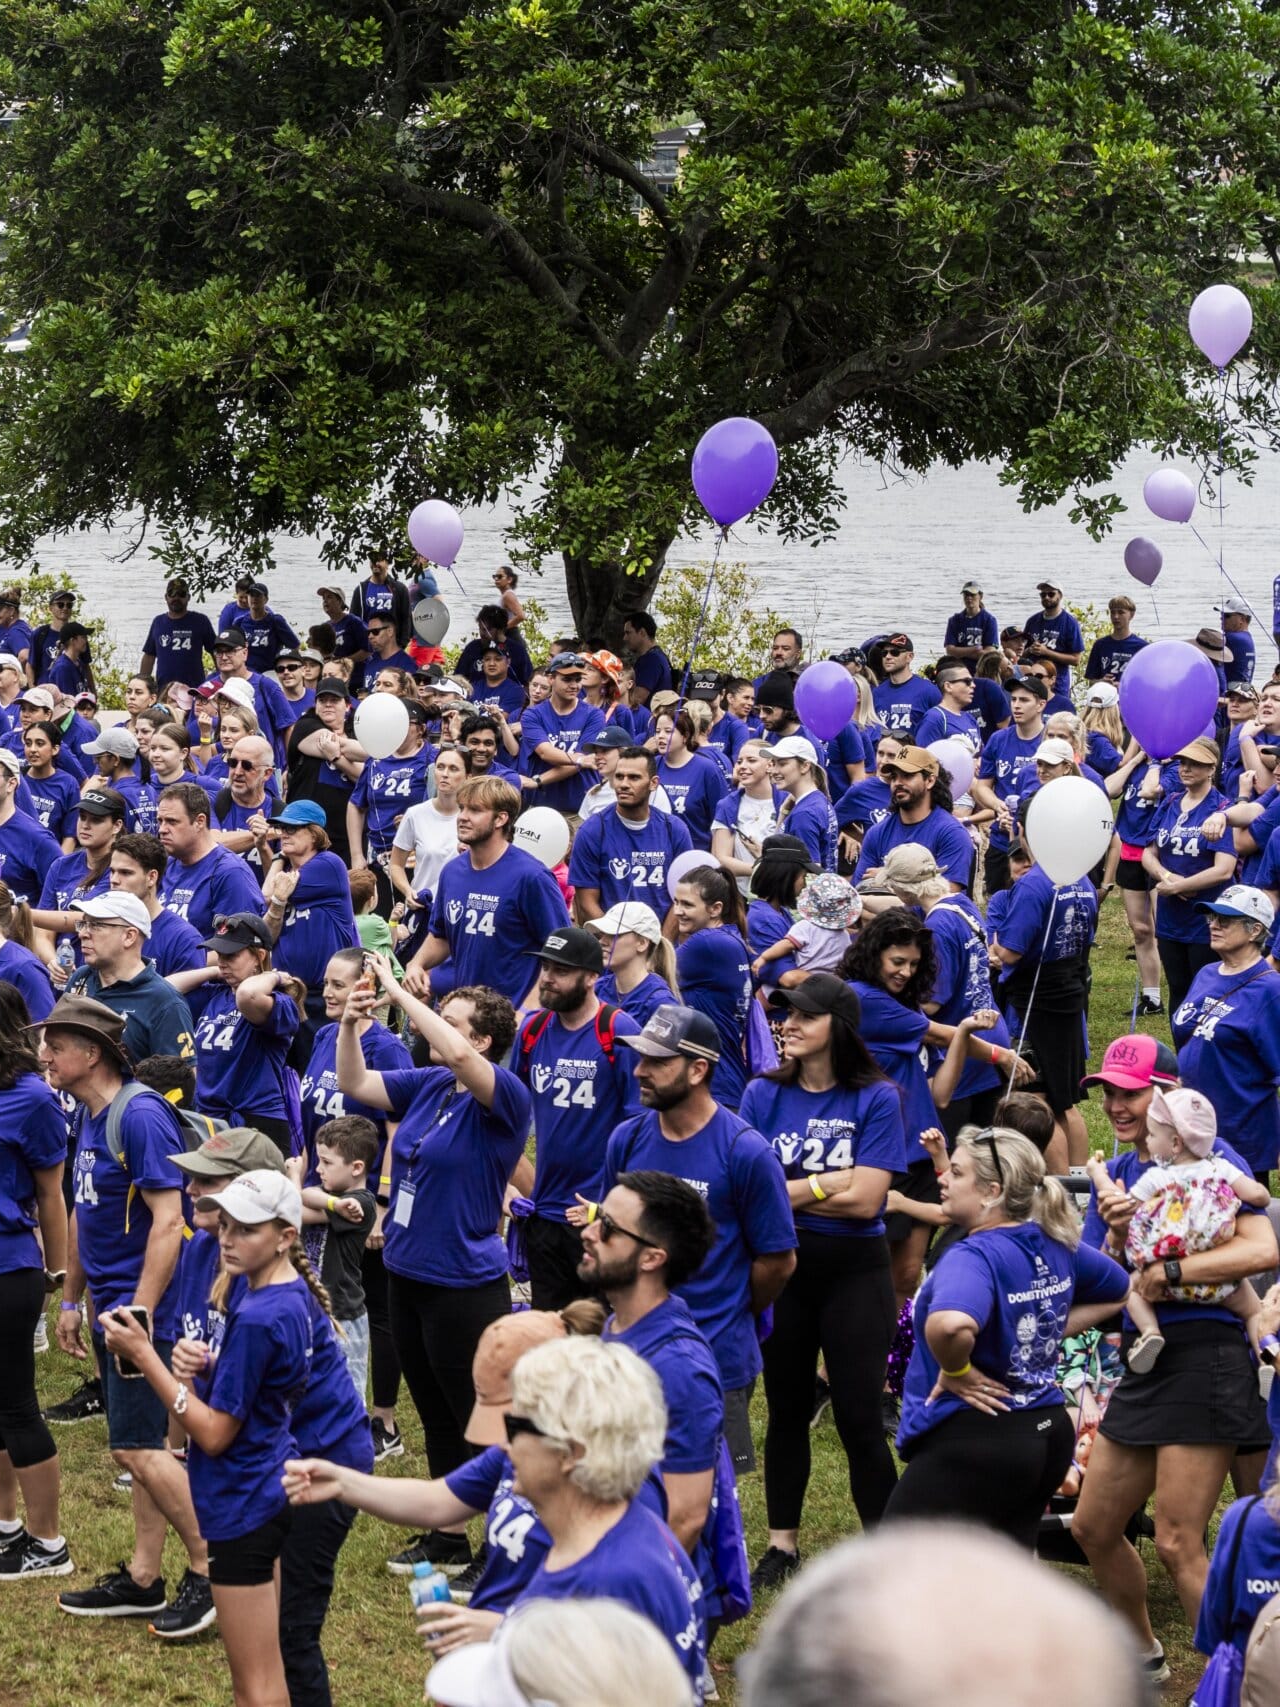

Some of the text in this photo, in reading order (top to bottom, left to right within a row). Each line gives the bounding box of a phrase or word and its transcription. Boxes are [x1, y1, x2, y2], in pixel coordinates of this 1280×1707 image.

[377, 600, 393, 610] 24
[173, 638, 192, 650] 24
[252, 637, 269, 647] 24
[968, 635, 982, 646] 24
[892, 714, 912, 729] 24
[385, 779, 412, 797] 24
[674, 797, 686, 814] 4
[39, 813, 50, 827] 4
[515, 827, 541, 841] ITAN
[1170, 839, 1200, 857] 24
[631, 866, 665, 887] 24
[464, 910, 496, 936] 24
[202, 1024, 235, 1051] 24
[576, 1059, 597, 1068] WALK
[555, 1067, 597, 1079] FOR DV
[553, 1078, 597, 1109] 24
[314, 1088, 346, 1119] 24
[808, 1119, 856, 1130] EPIC WALK
[806, 1128, 829, 1139] FOR
[802, 1139, 855, 1171] 24
